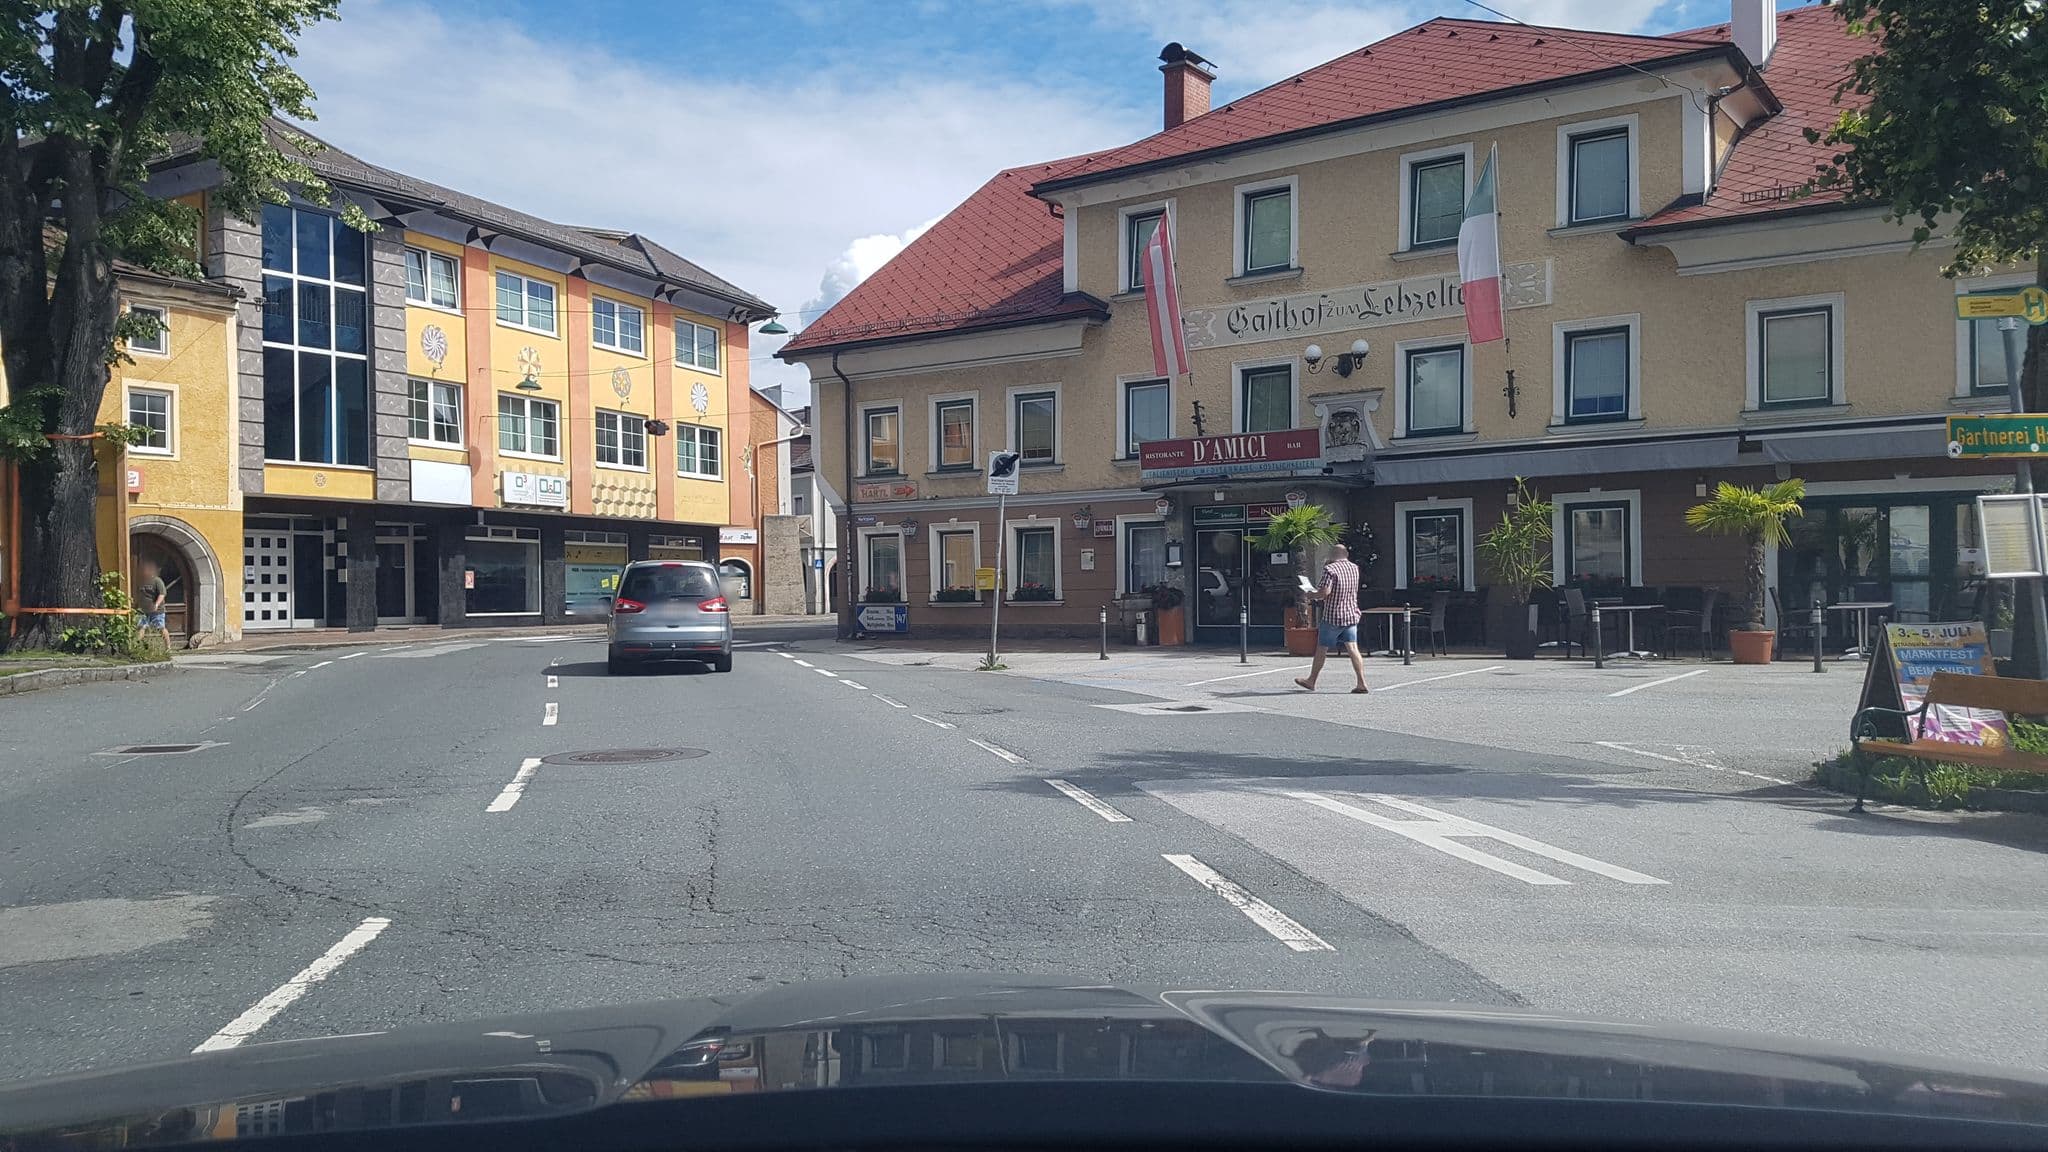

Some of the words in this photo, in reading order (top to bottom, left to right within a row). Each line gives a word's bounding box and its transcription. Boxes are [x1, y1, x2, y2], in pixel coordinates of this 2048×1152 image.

[1358, 278, 1465, 320] Lebzelte
[1145, 450, 1185, 460] RISTORANTE
[1287, 441, 1301, 449] BAR
[895, 613, 906, 624] 147
[1939, 626, 1972, 639] JULI
[1901, 649, 1975, 660] MARKTFEST
